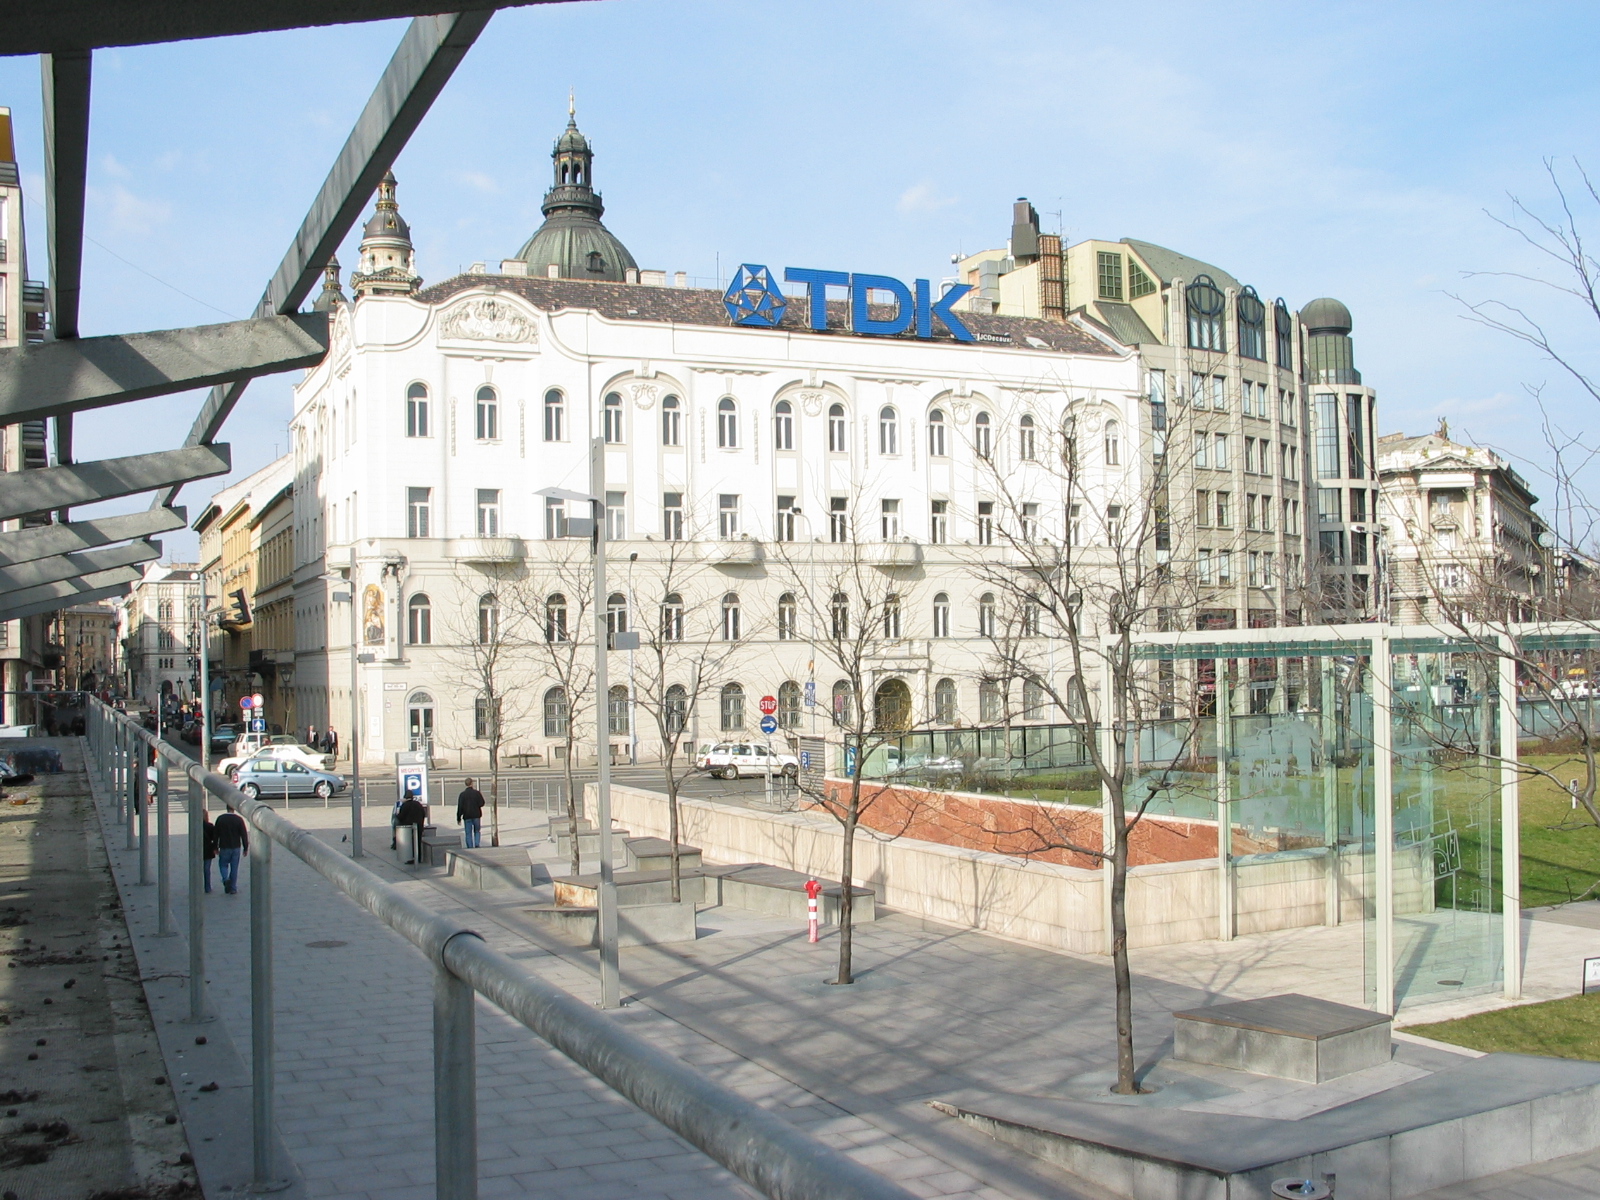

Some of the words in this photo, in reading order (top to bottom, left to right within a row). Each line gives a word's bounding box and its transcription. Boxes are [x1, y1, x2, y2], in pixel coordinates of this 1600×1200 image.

[785, 266, 975, 342] TDK
[979, 333, 1013, 343] JCDecaux
[761, 701, 776, 710] STOP
